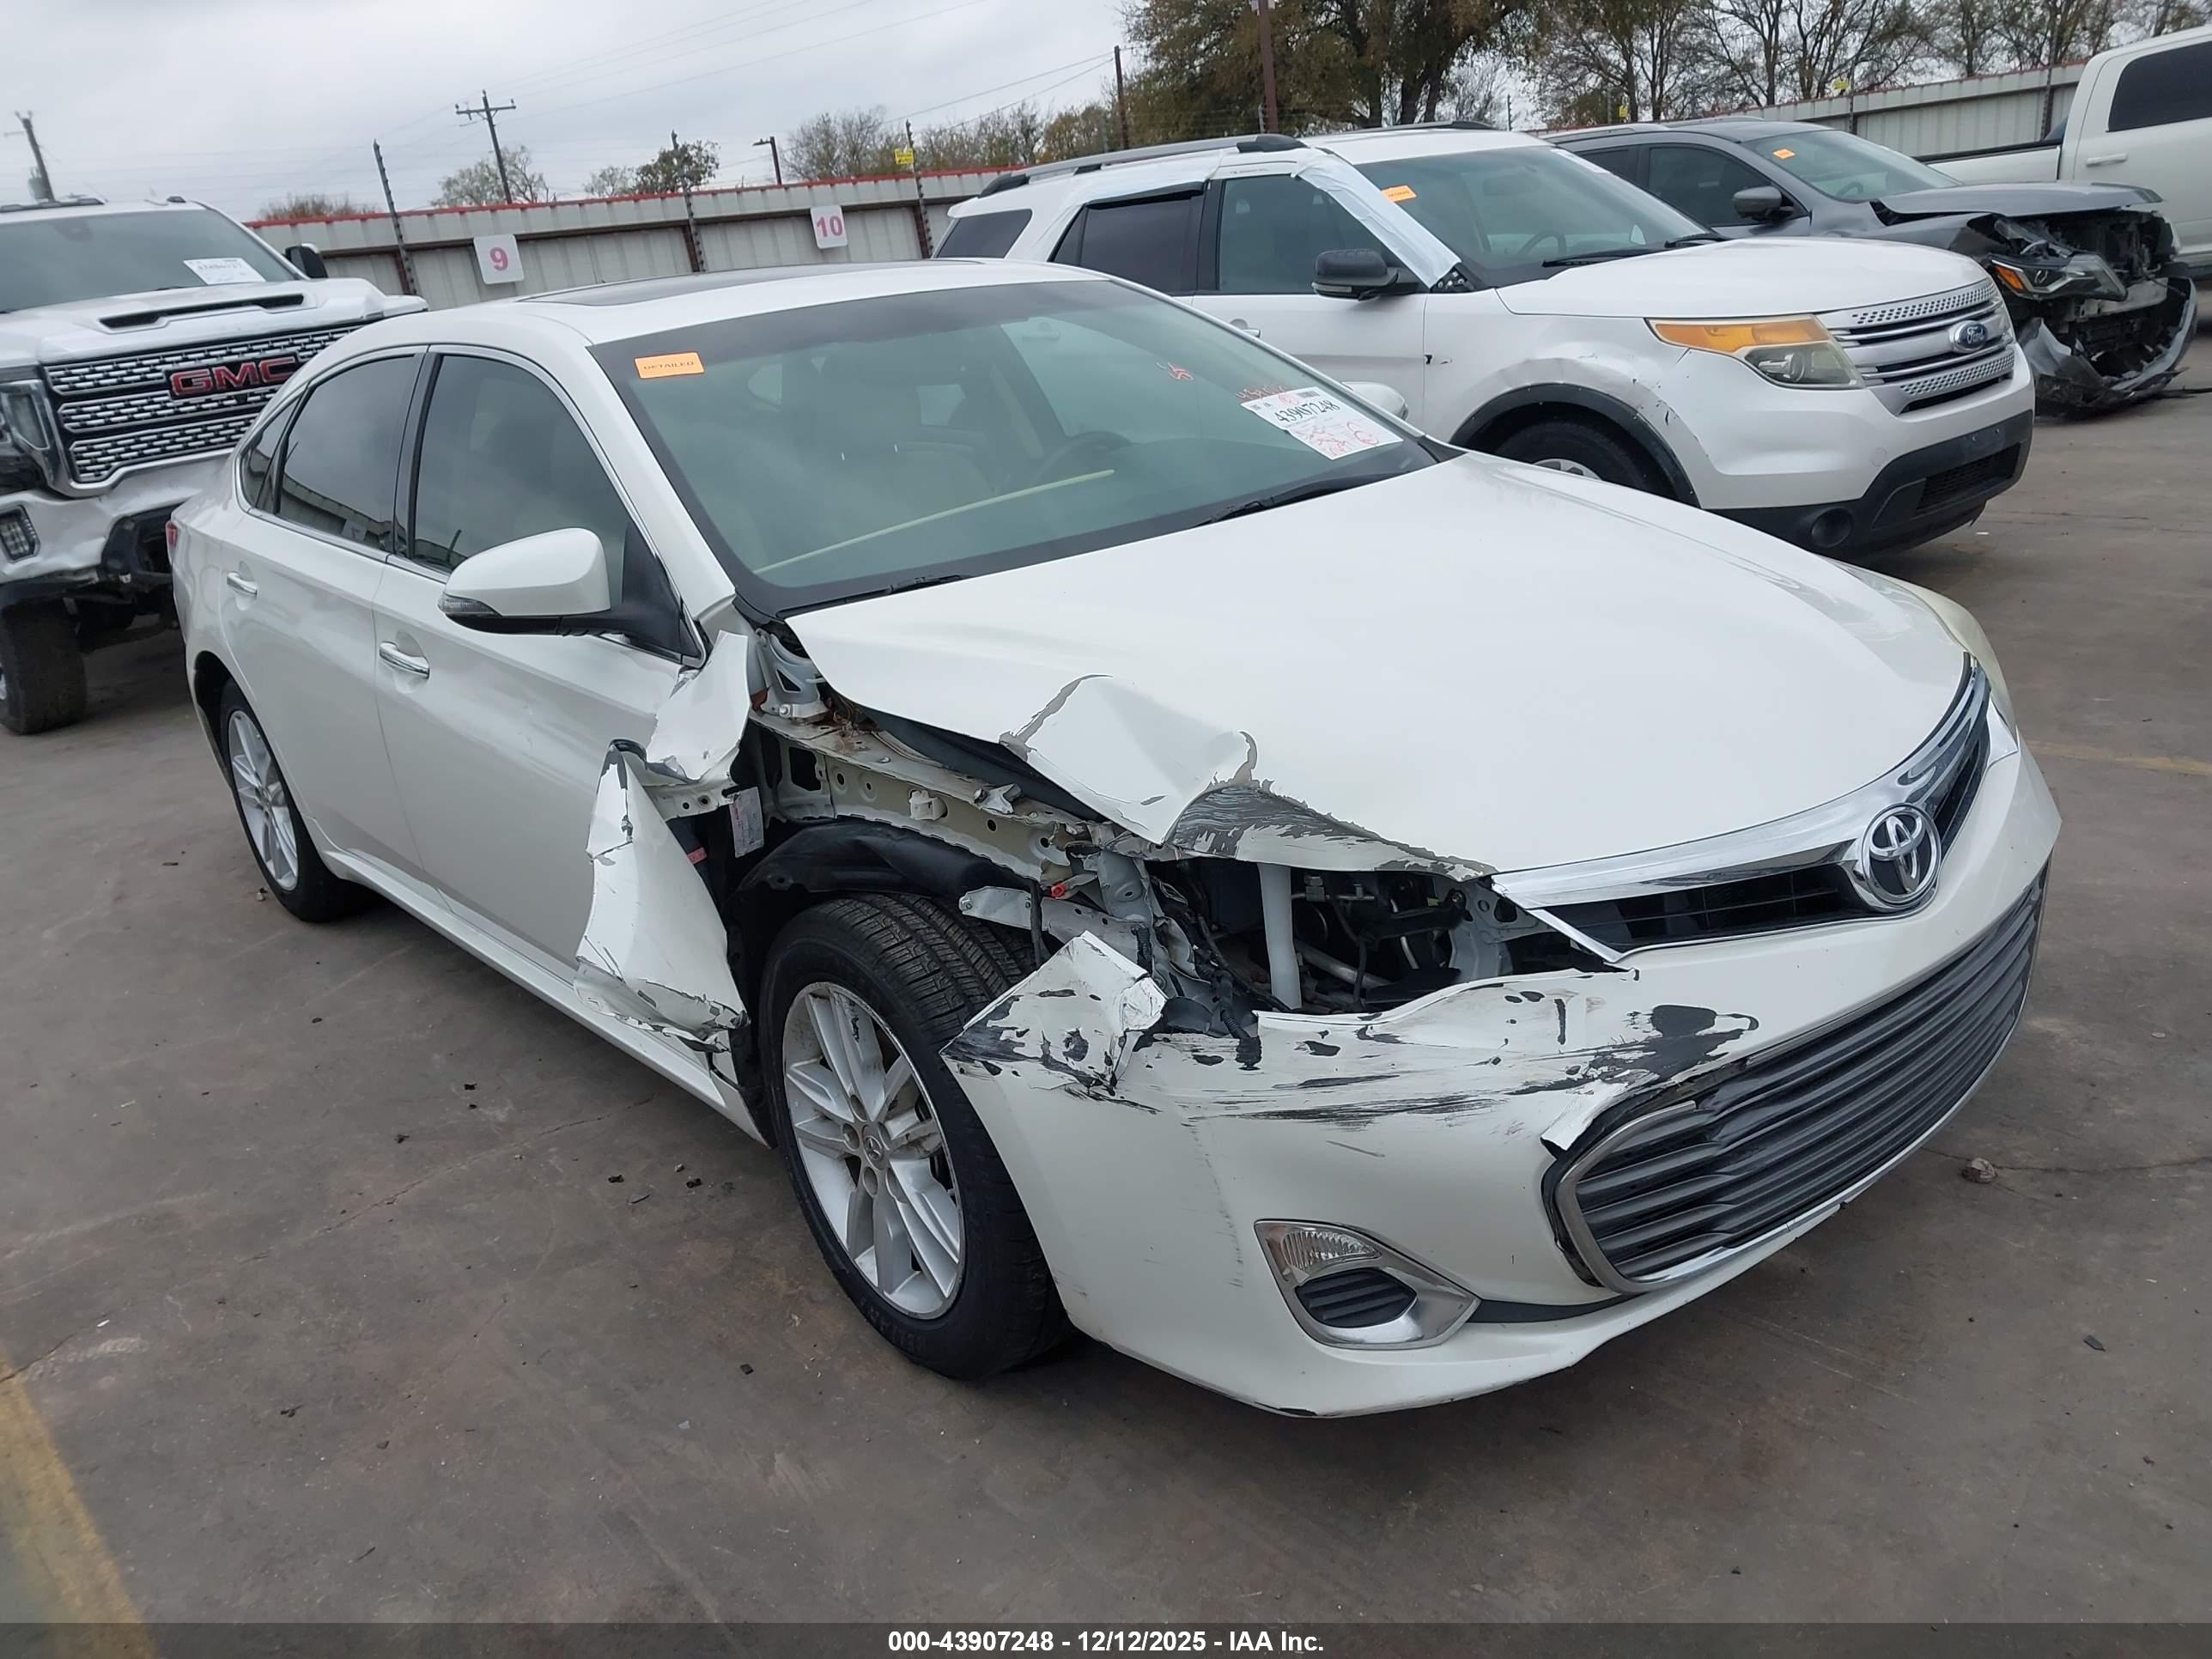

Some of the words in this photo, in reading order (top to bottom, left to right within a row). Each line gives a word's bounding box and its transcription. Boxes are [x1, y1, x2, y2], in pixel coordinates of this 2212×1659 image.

[816, 216, 843, 238] 10
[489, 246, 509, 271] 9
[1966, 325, 1984, 344] Ford
[170, 356, 296, 396] GMC
[1274, 399, 1341, 424] 43907248
